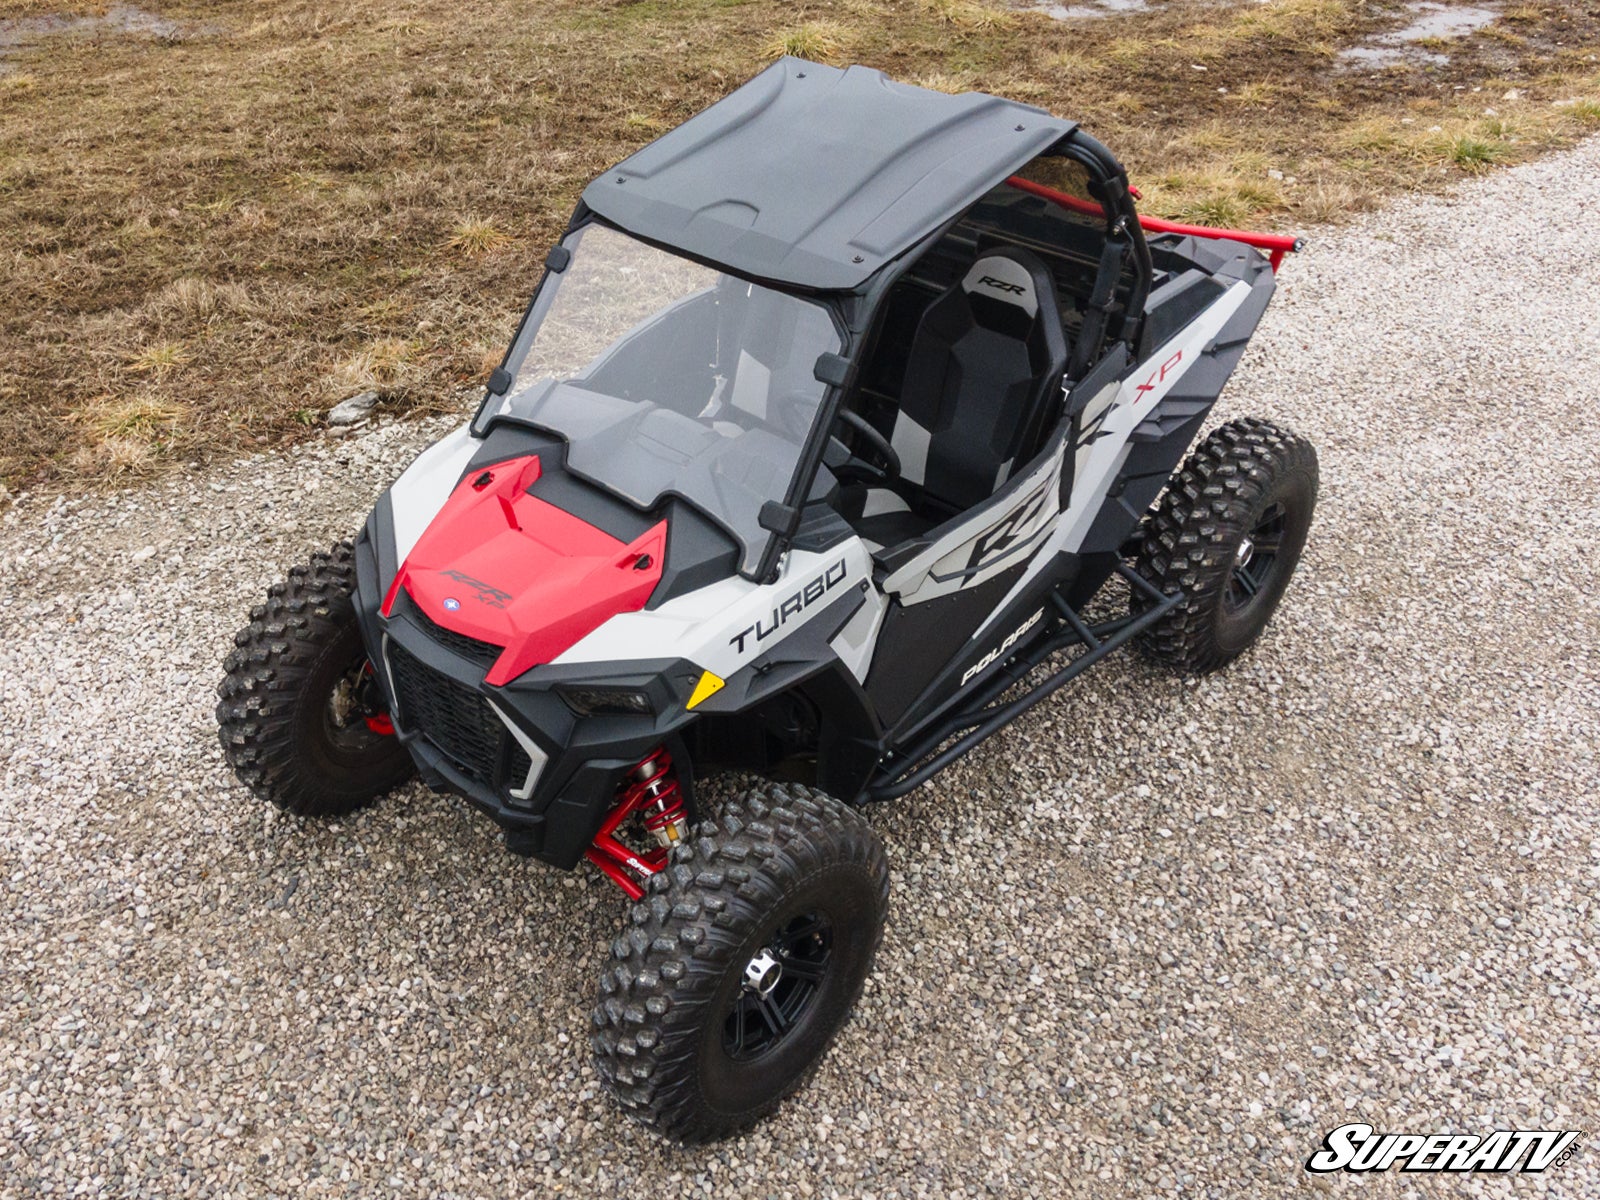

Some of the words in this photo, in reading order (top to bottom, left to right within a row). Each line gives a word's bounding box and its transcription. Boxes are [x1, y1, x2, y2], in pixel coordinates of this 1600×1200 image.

[978, 276, 1026, 296] RZR
[1133, 349, 1182, 406] XP
[439, 569, 513, 602] RZR
[472, 593, 506, 609] XP
[729, 558, 847, 654] TURBO
[961, 606, 1045, 687] POLARIS
